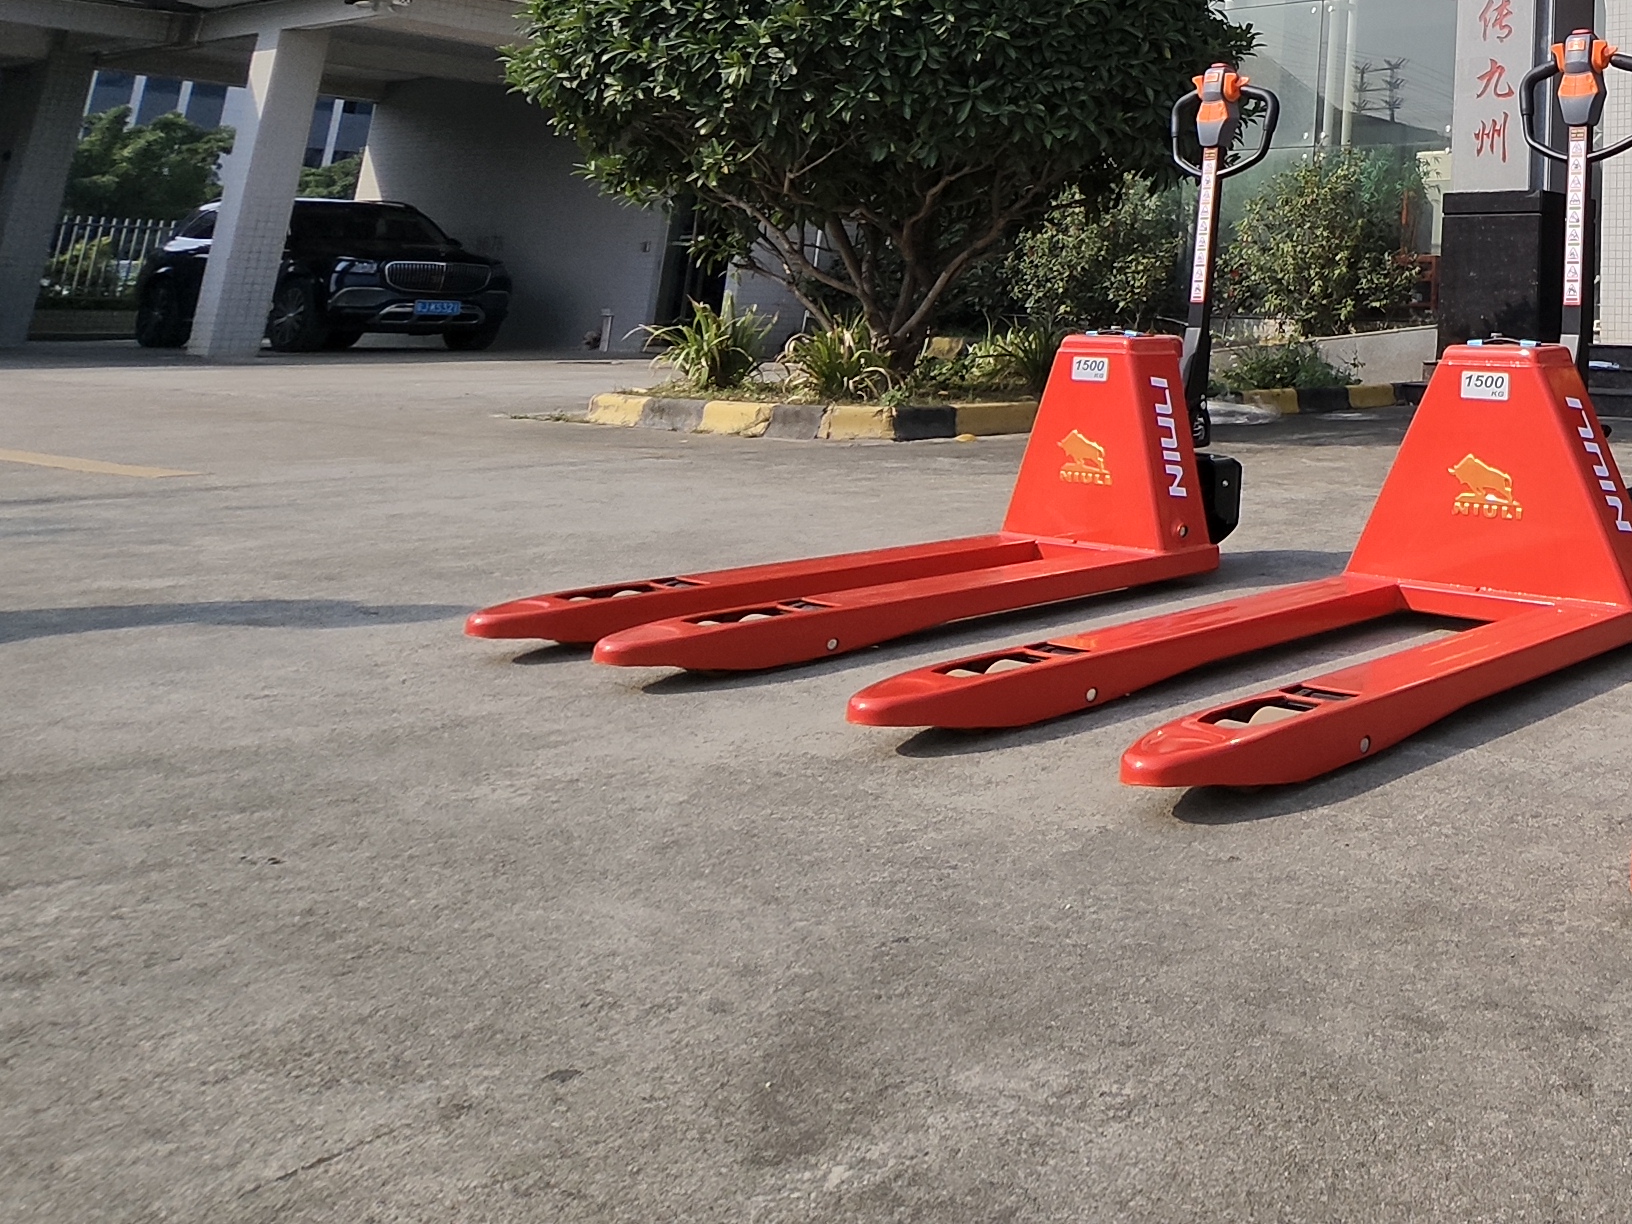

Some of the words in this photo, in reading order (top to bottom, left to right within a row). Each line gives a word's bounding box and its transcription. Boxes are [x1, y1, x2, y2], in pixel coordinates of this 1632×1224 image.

[1075, 359, 1105, 372] 1500
[1465, 374, 1504, 389] 1500
[1491, 390, 1504, 398] KG
[1150, 376, 1188, 497] NIULI
[1565, 396, 1632, 532] NIULI
[1059, 470, 1113, 486] NIULI
[1451, 501, 1523, 520] NIULI
